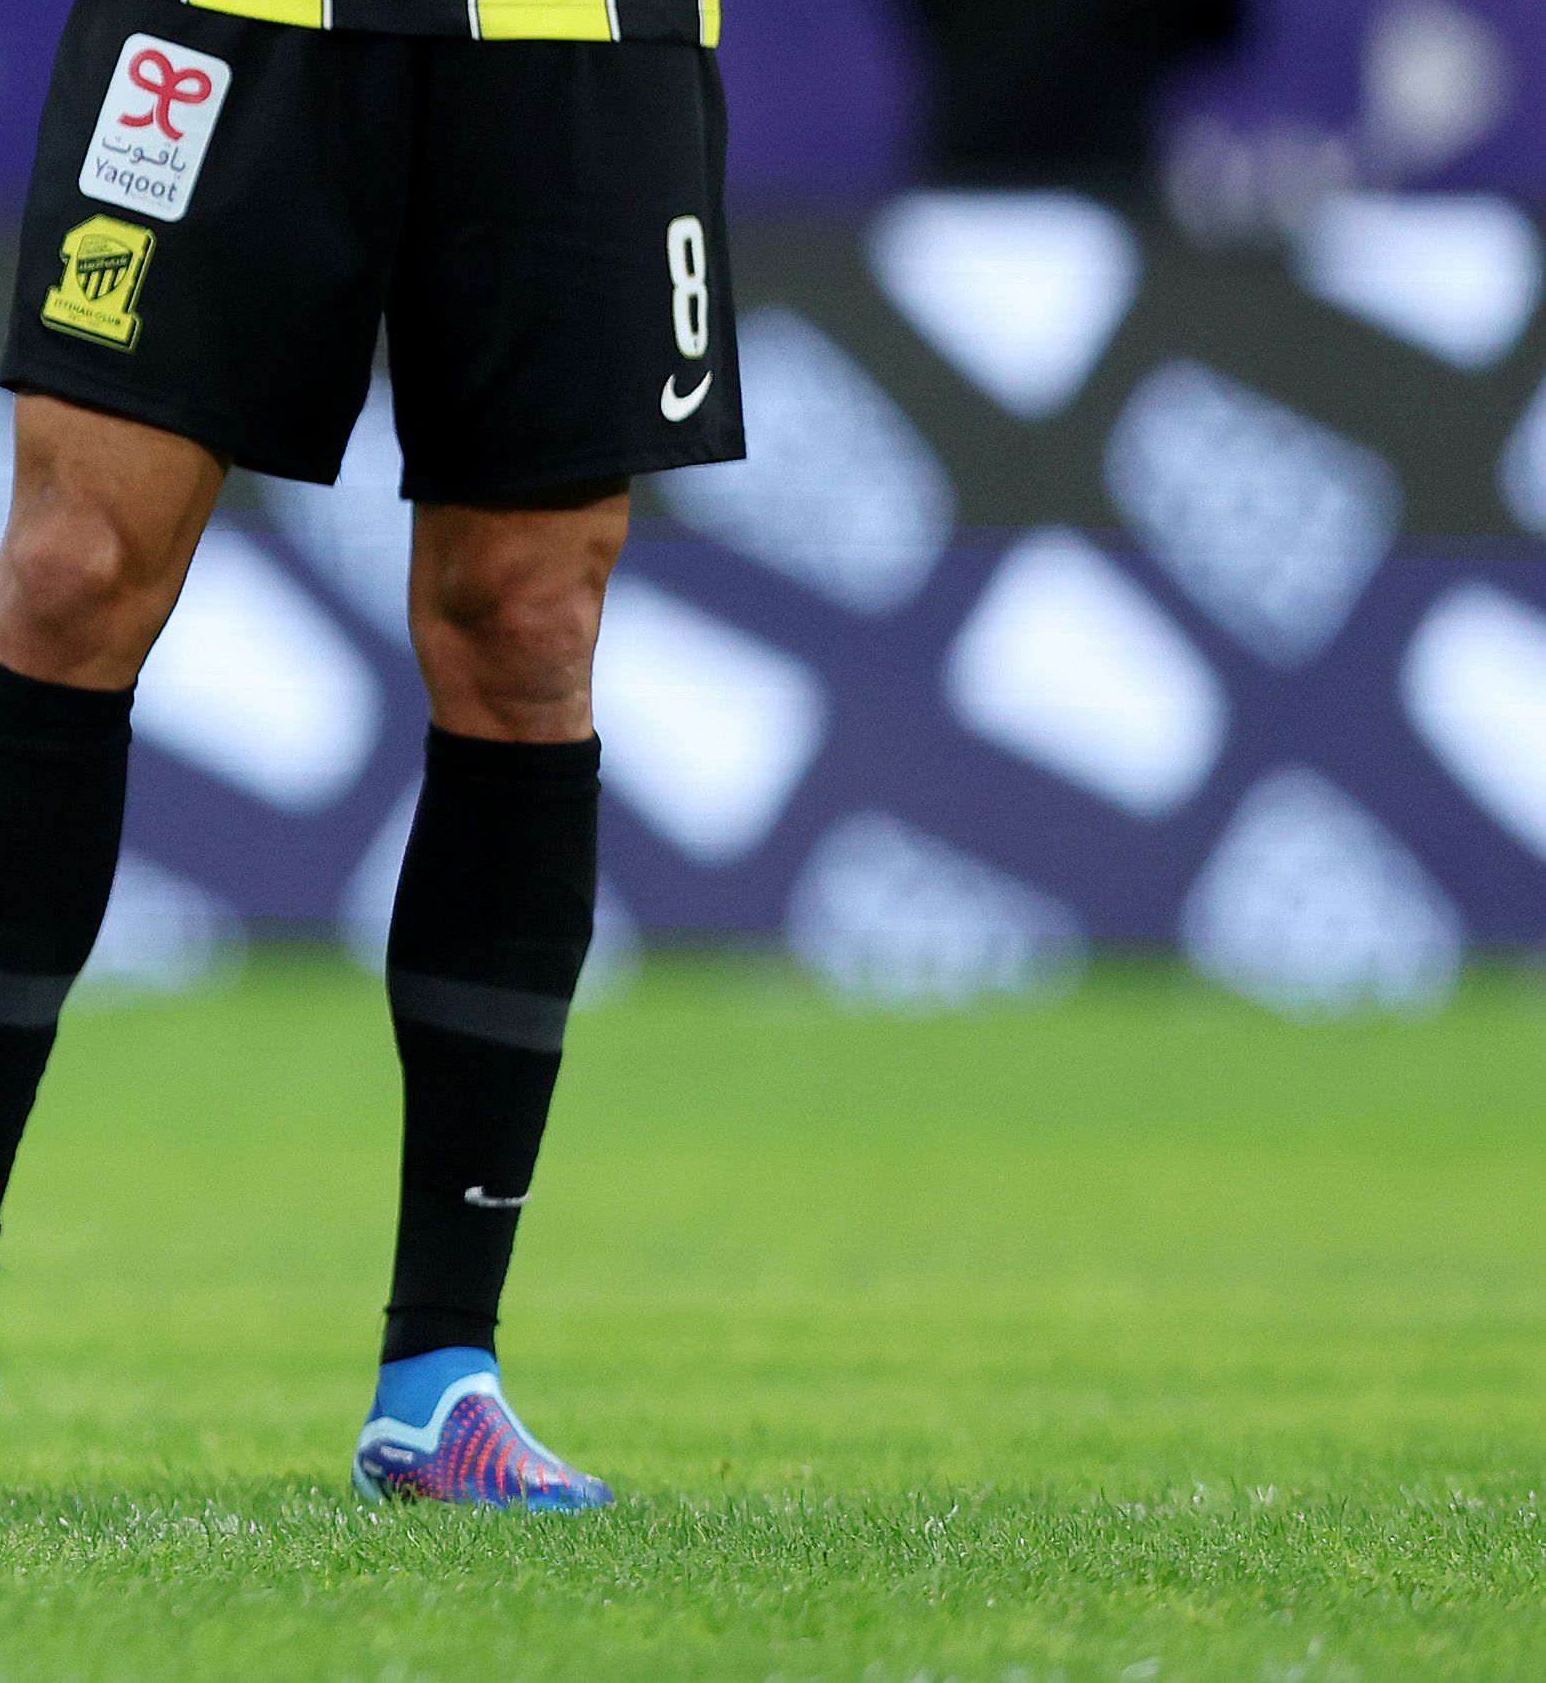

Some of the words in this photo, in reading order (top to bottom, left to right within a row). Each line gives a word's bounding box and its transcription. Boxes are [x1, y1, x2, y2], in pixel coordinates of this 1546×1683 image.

[95, 157, 177, 202] Yaqoot
[101, 136, 186, 181] ياقوت
[666, 215, 709, 359] 8
